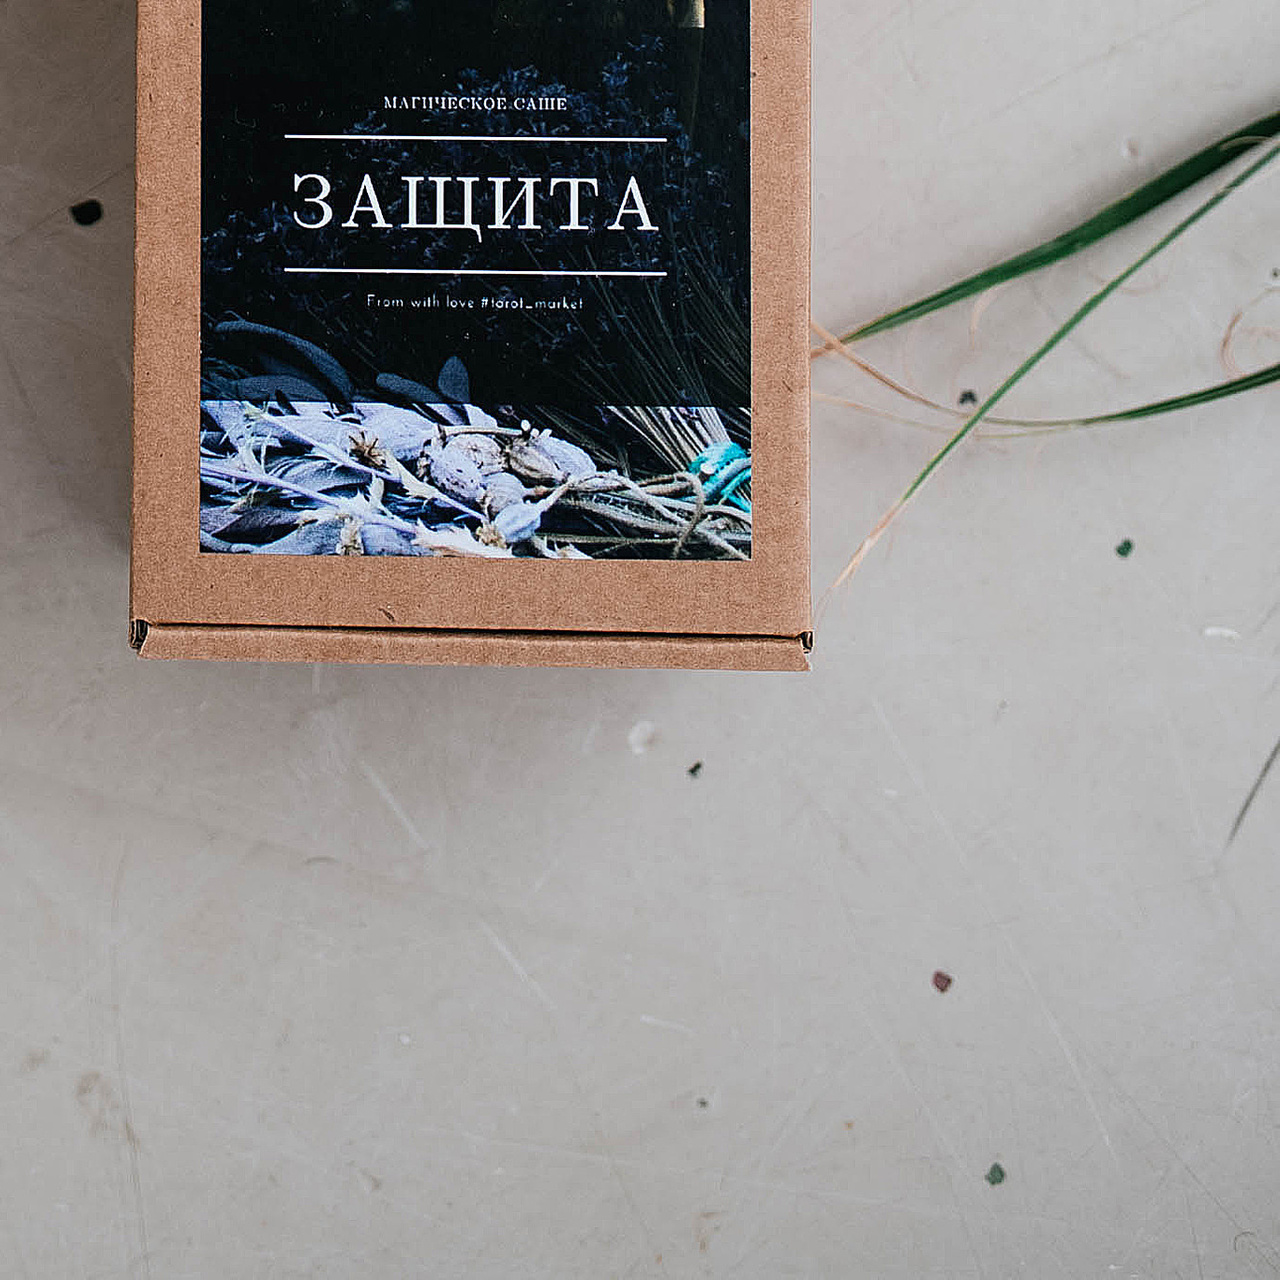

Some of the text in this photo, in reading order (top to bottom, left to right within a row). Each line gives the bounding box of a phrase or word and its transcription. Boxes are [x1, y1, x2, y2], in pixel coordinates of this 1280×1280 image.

[383, 95, 568, 112] МАГИЧЕСКОЕ САШЕ
[292, 173, 660, 243] ЗАЩИТА
[366, 293, 405, 309] From
[410, 294, 440, 309] with
[445, 294, 475, 310] love
